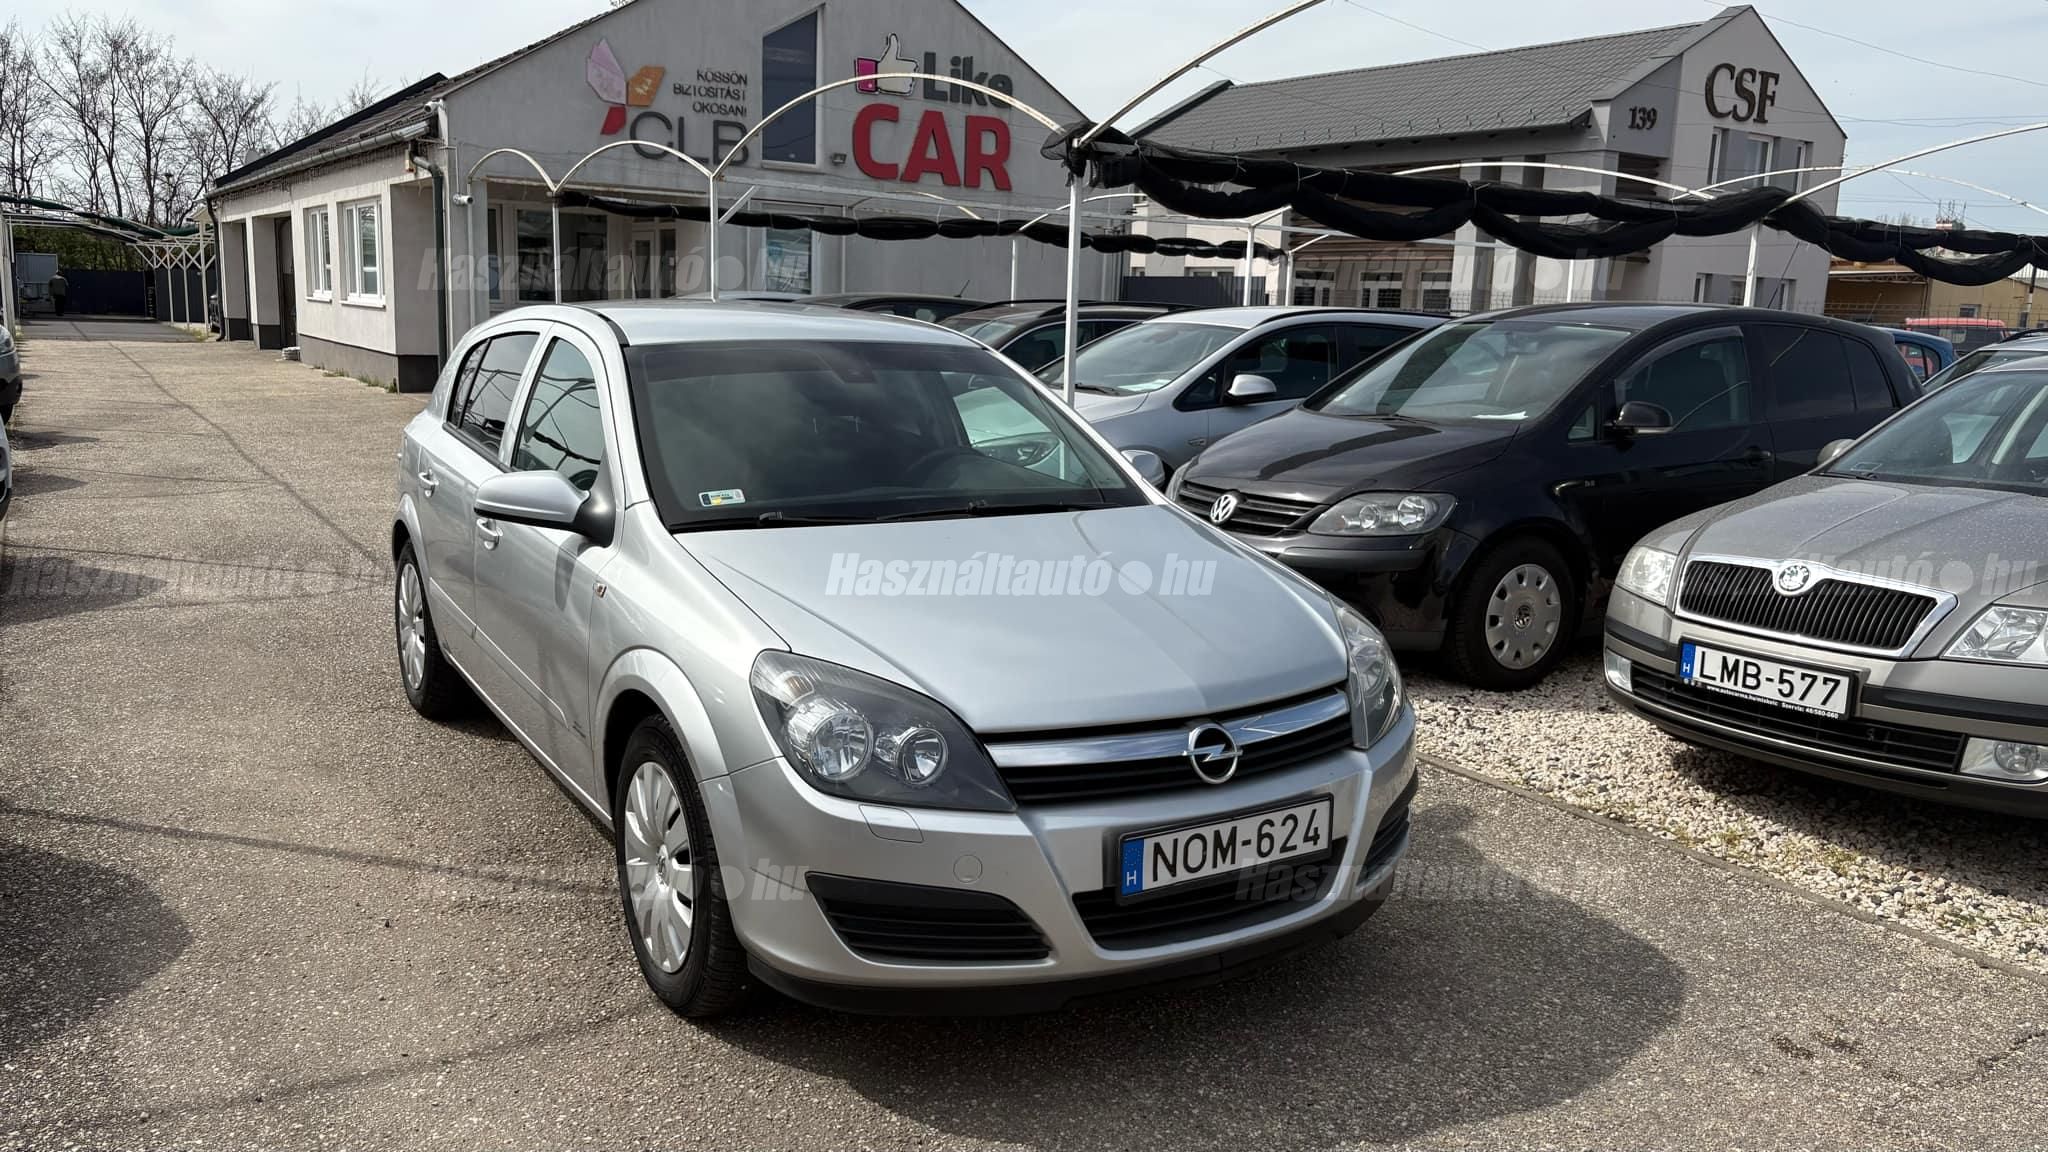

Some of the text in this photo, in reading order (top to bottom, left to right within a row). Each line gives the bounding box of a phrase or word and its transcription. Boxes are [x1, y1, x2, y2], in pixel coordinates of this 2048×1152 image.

[923, 51, 1013, 110] Like
[1704, 63, 1780, 124] CSF
[630, 111, 749, 167] CLB
[852, 103, 1013, 191] CAR
[1628, 106, 1658, 131] 139
[1682, 651, 1841, 707] H LMB-577
[1126, 870, 1137, 887] H
[1152, 808, 1320, 882] NOM-624
